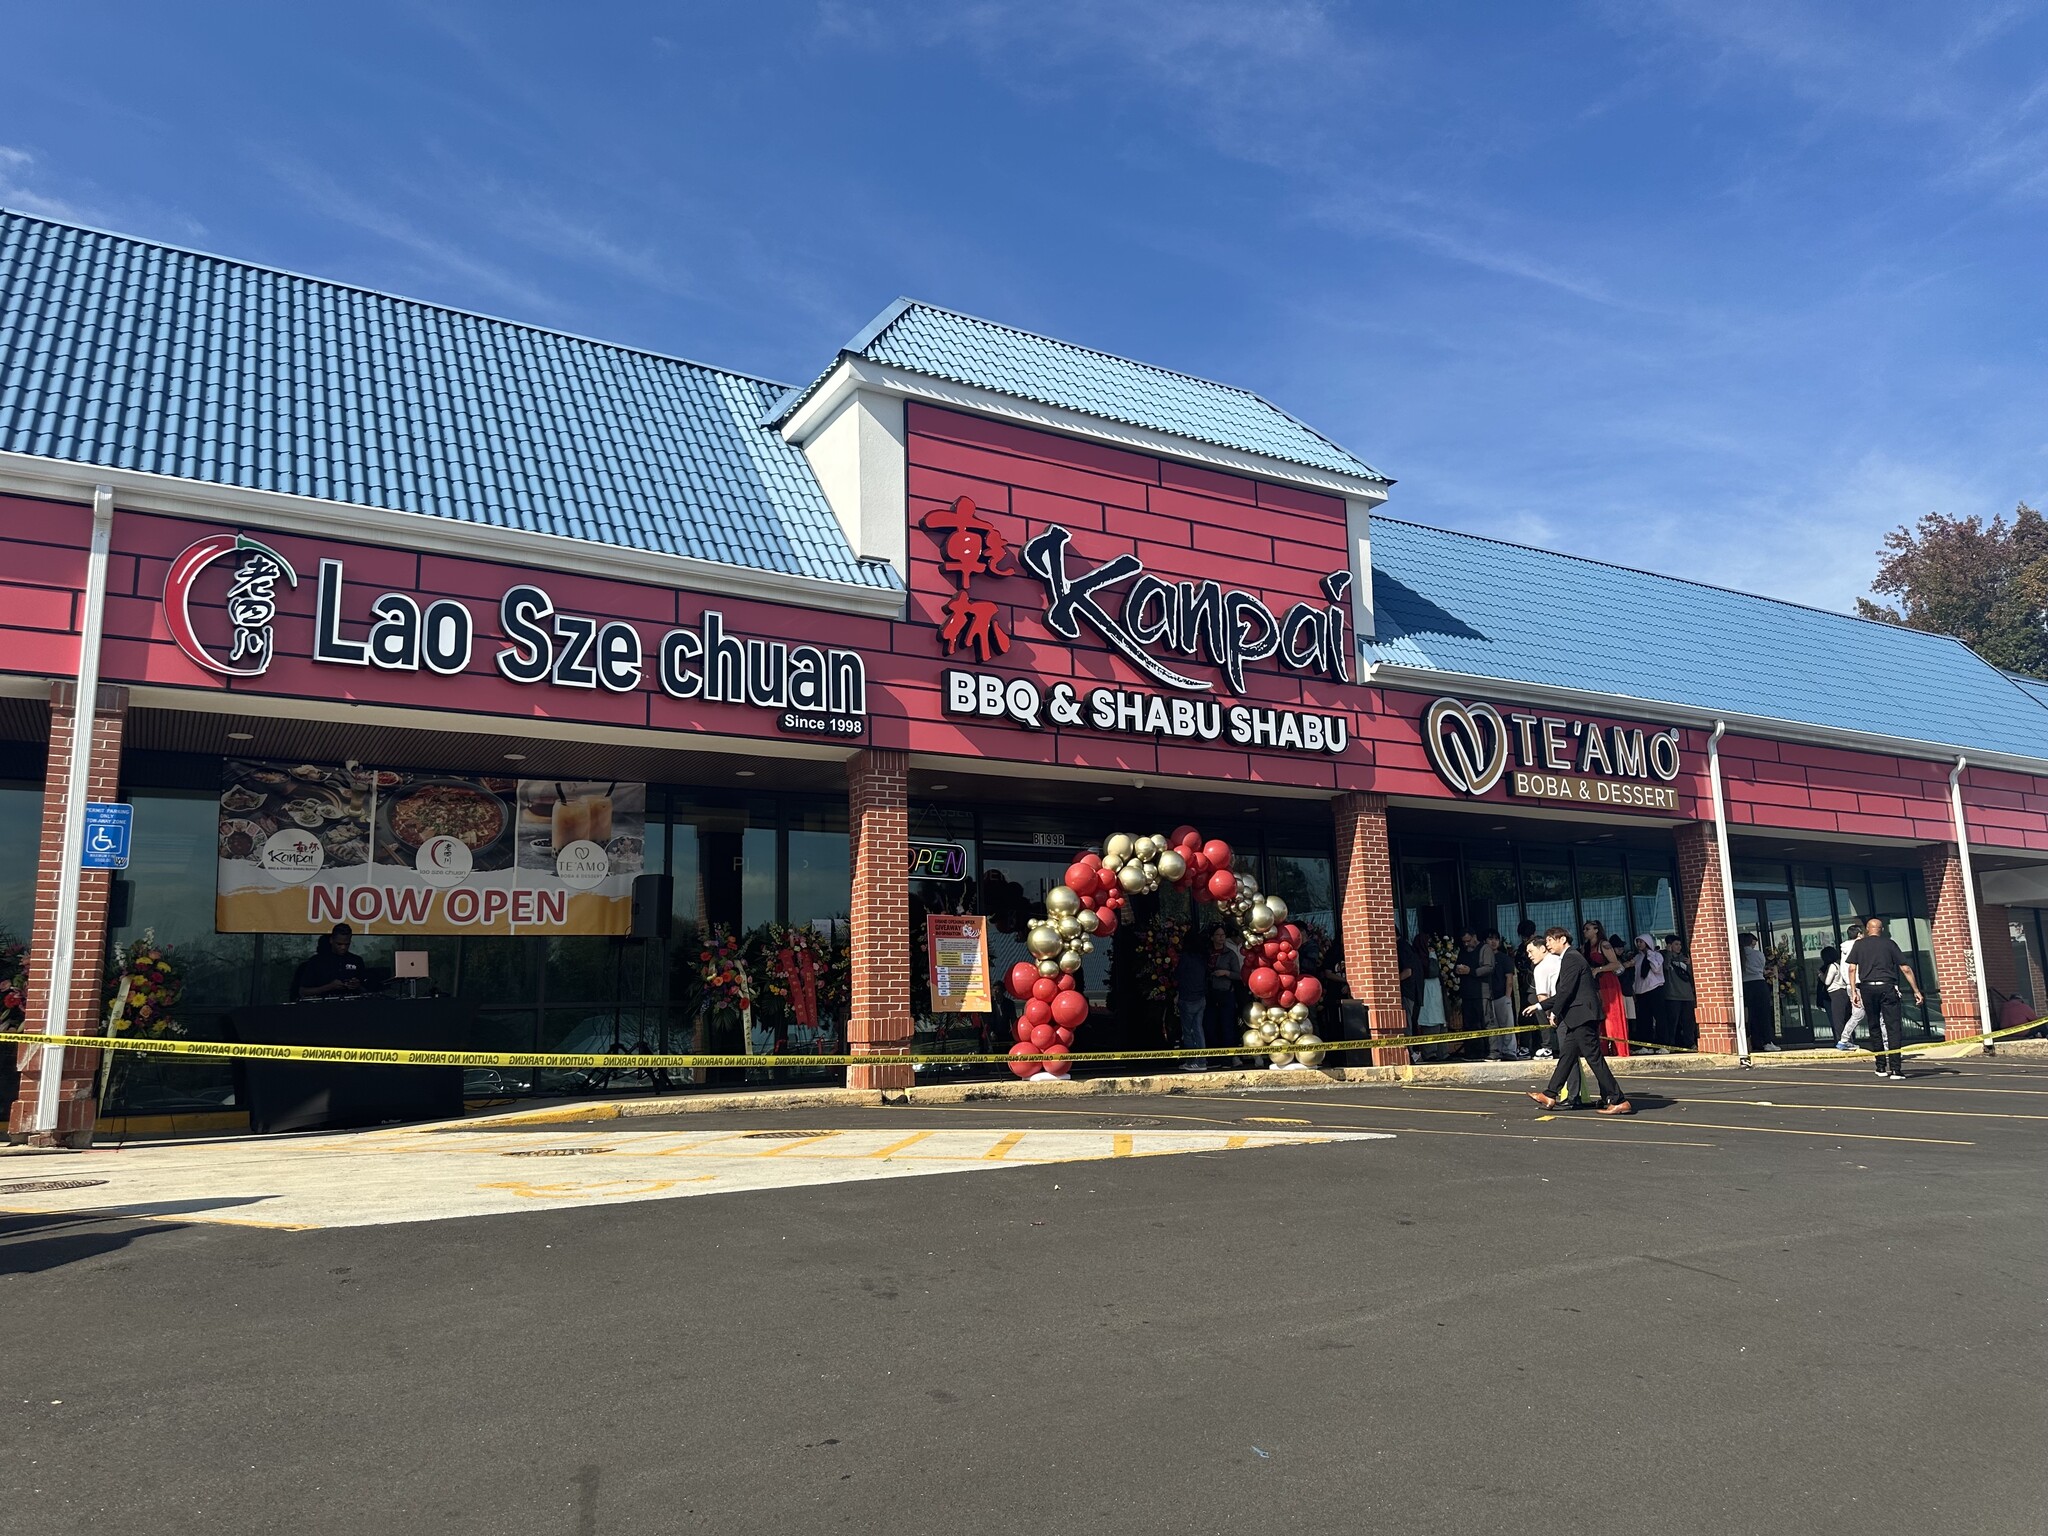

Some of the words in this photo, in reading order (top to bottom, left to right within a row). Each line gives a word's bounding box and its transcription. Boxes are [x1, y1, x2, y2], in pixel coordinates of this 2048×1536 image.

[1019, 523, 1353, 695] Kanpai
[313, 558, 473, 675] Lao
[496, 584, 642, 693] Sze
[657, 610, 866, 715] chuan
[784, 713, 826, 731] Since
[829, 716, 863, 734] 1998
[945, 671, 1041, 727] BBQ
[1049, 683, 1083, 725] &
[1092, 690, 1221, 741] SHABU
[1229, 706, 1348, 754] SHABU
[1517, 773, 1573, 798] BOBA
[1579, 780, 1591, 800] &
[1597, 782, 1676, 808] DESSERT
[268, 850, 316, 866] Kanpai
[311, 884, 431, 923] NOW
[446, 888, 565, 923] OPEN
